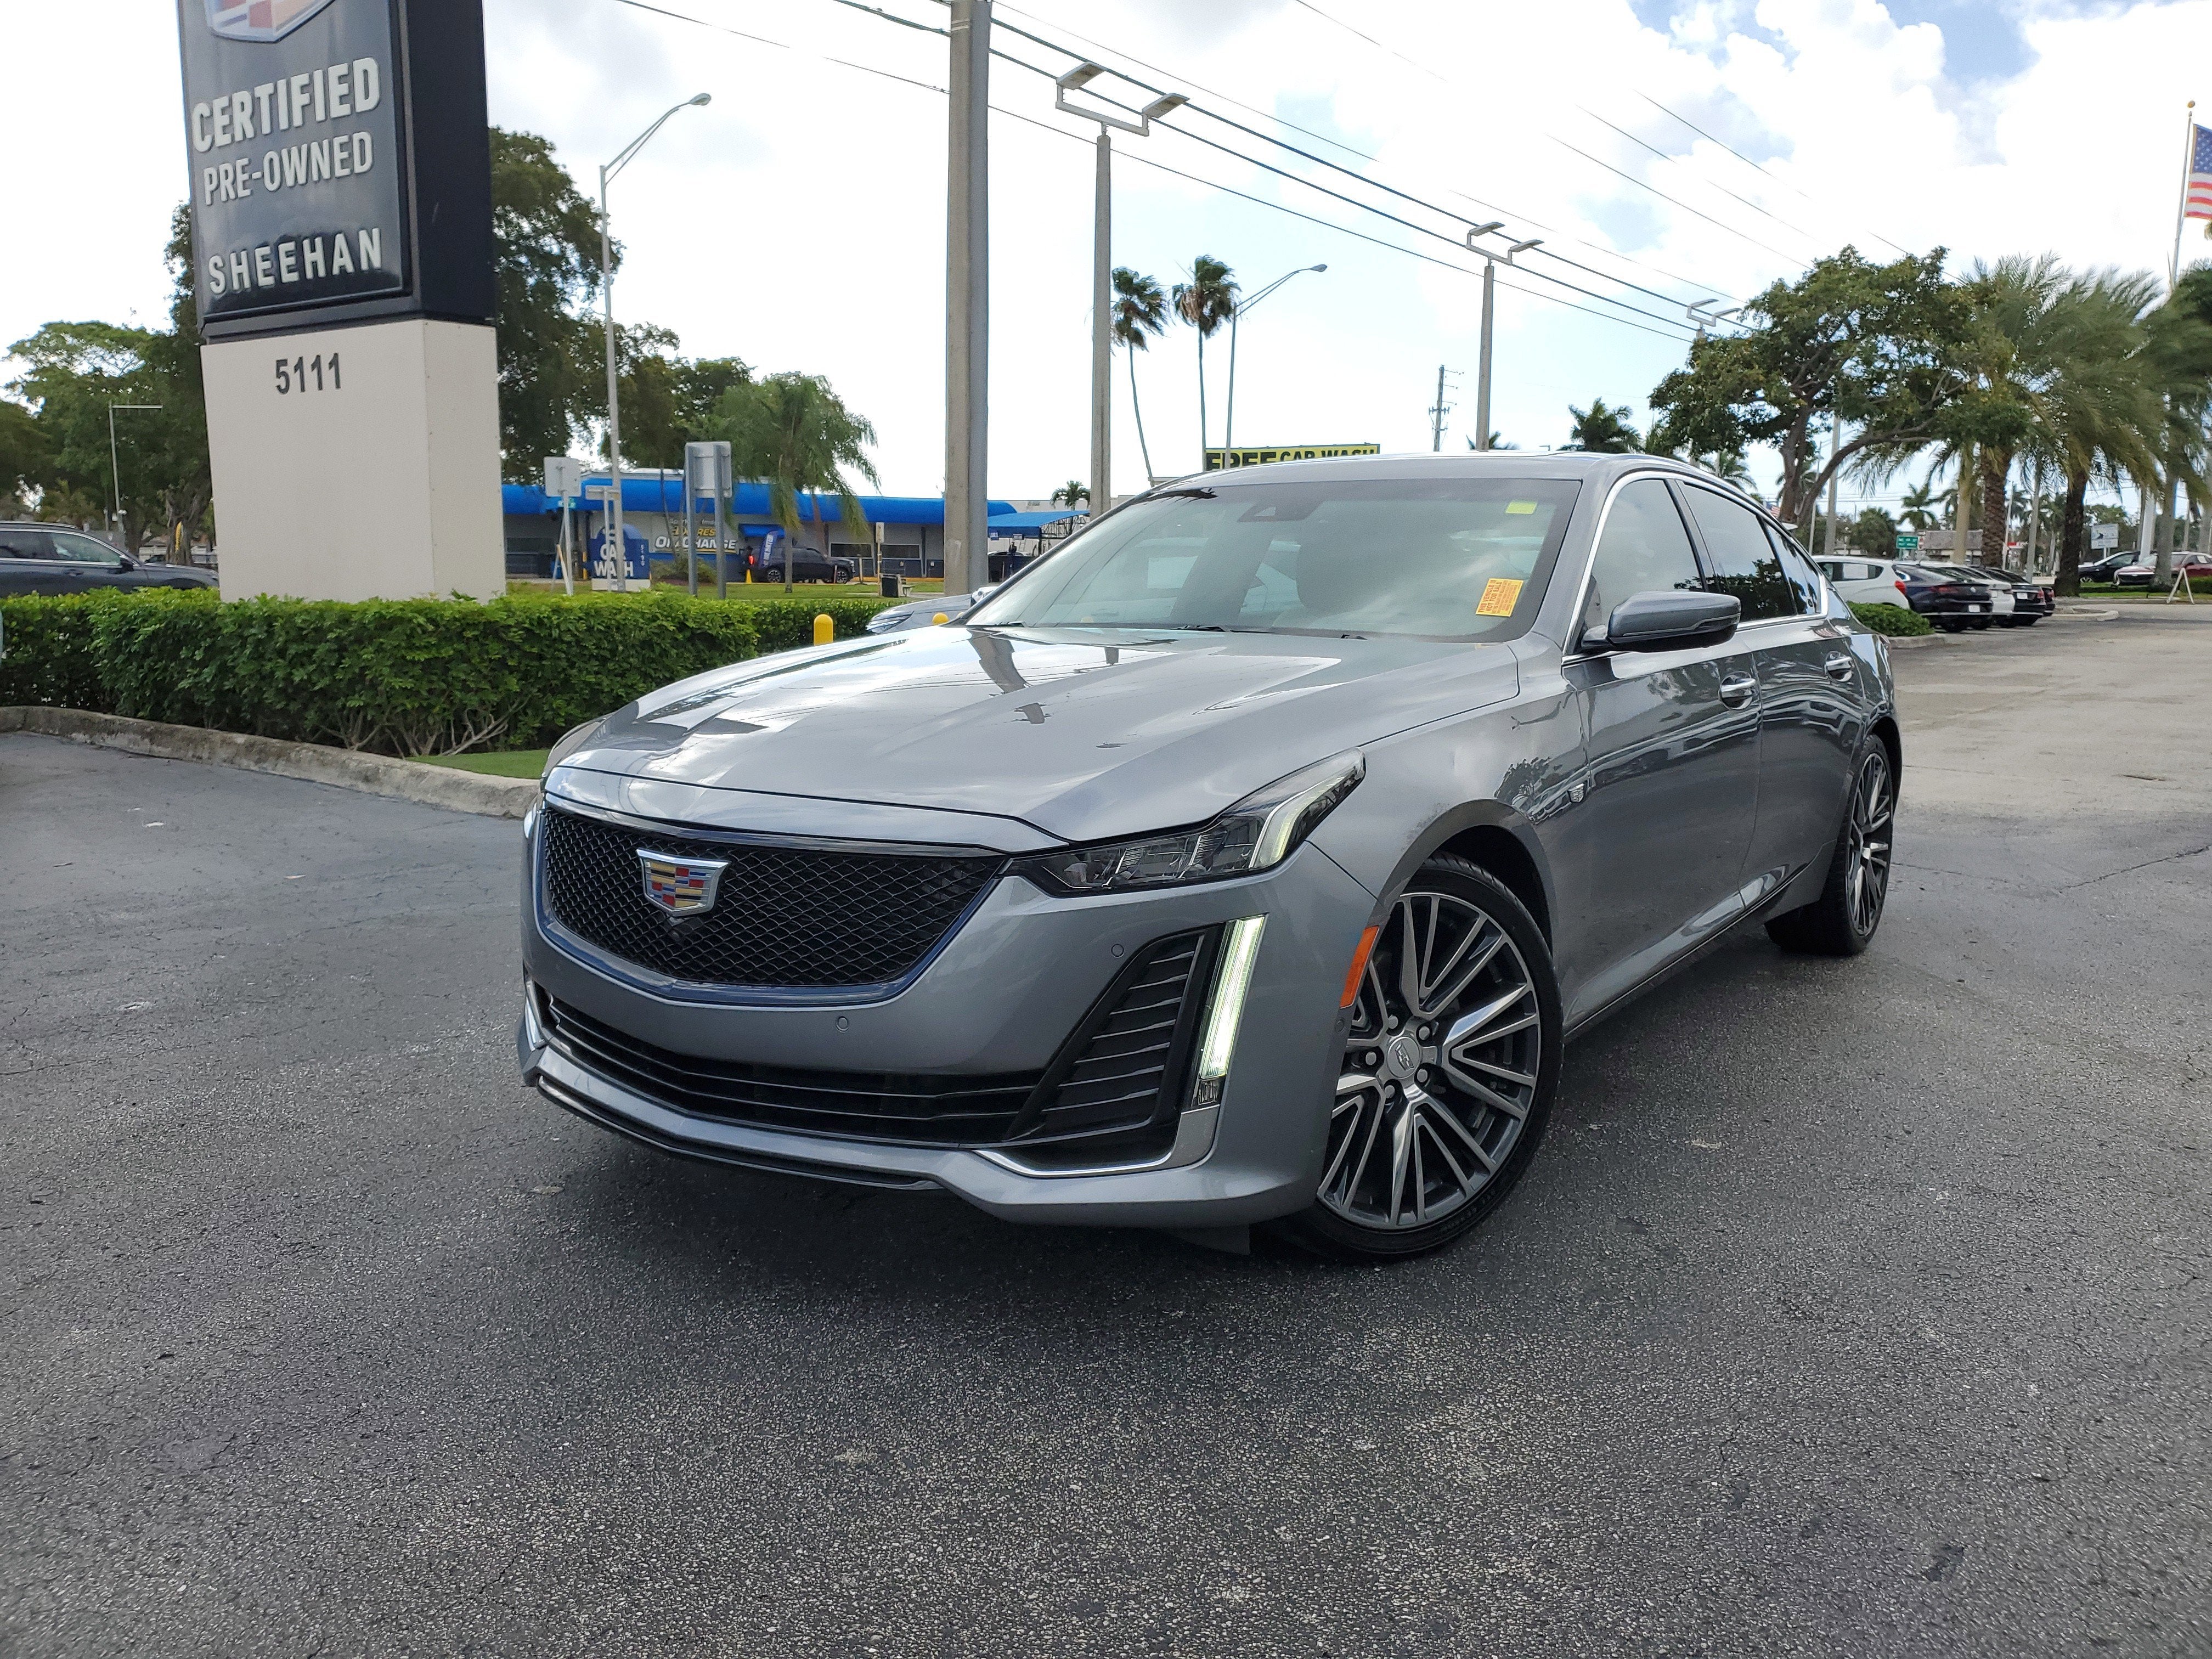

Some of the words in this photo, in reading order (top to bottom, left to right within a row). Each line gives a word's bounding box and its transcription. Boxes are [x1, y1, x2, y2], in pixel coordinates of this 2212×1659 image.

[192, 57, 380, 153] CERTIFIED
[203, 131, 373, 206] PRE-OWNED
[208, 228, 381, 294] SHEEHAN
[275, 353, 341, 394] 5111
[600, 544, 627, 560] CA
[593, 561, 634, 577] WAH
[1482, 584, 1494, 602] VEHICLE
[1493, 582, 1503, 592] SALE
[1489, 593, 1498, 602] FOR
[1478, 603, 1487, 613] THIS
